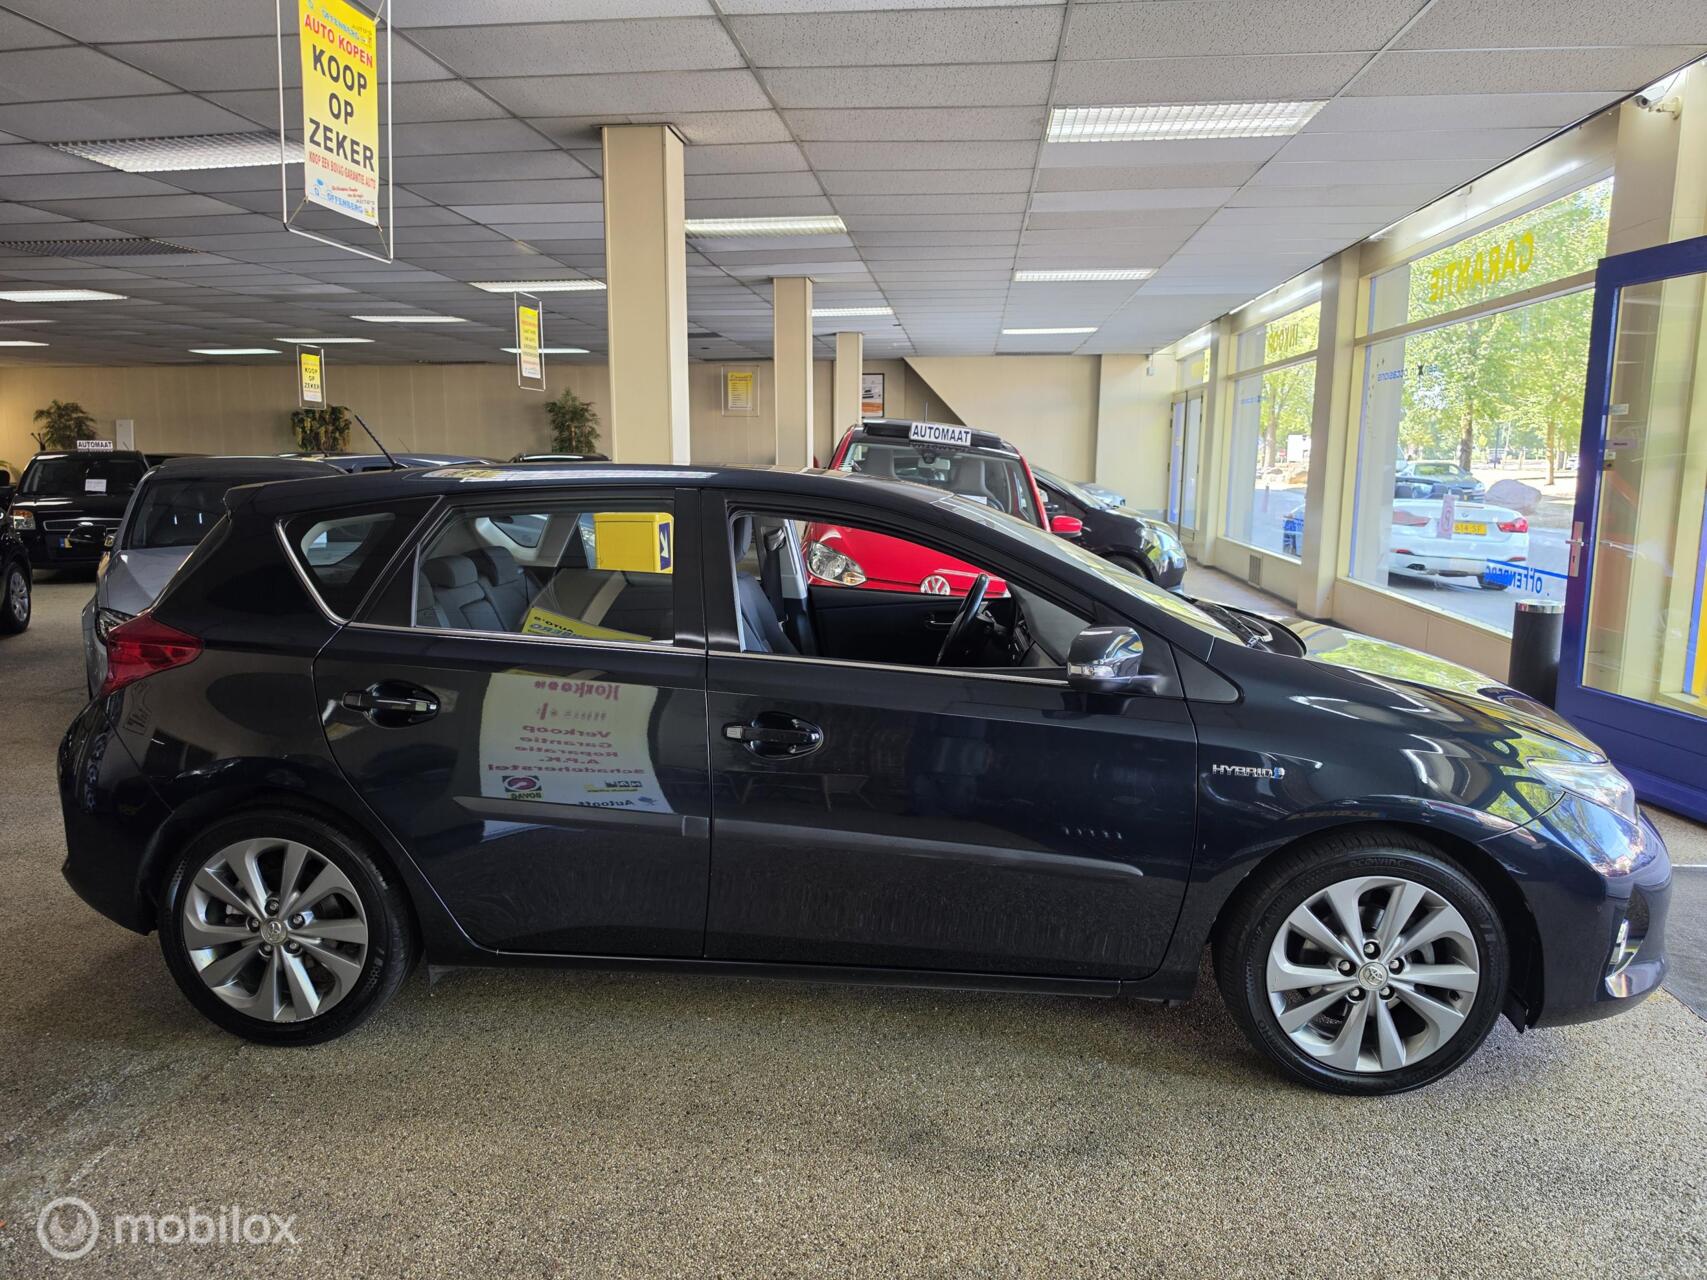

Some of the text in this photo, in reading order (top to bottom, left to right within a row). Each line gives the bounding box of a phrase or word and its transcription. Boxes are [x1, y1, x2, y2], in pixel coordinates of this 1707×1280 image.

[304, 14, 373, 68] AUTO KOPEN
[312, 43, 367, 97] KOOP
[329, 92, 354, 125] OP
[308, 117, 375, 173] ZEKER
[912, 424, 970, 443] AUTOMAAT
[1212, 764, 1273, 778] HYBRID
